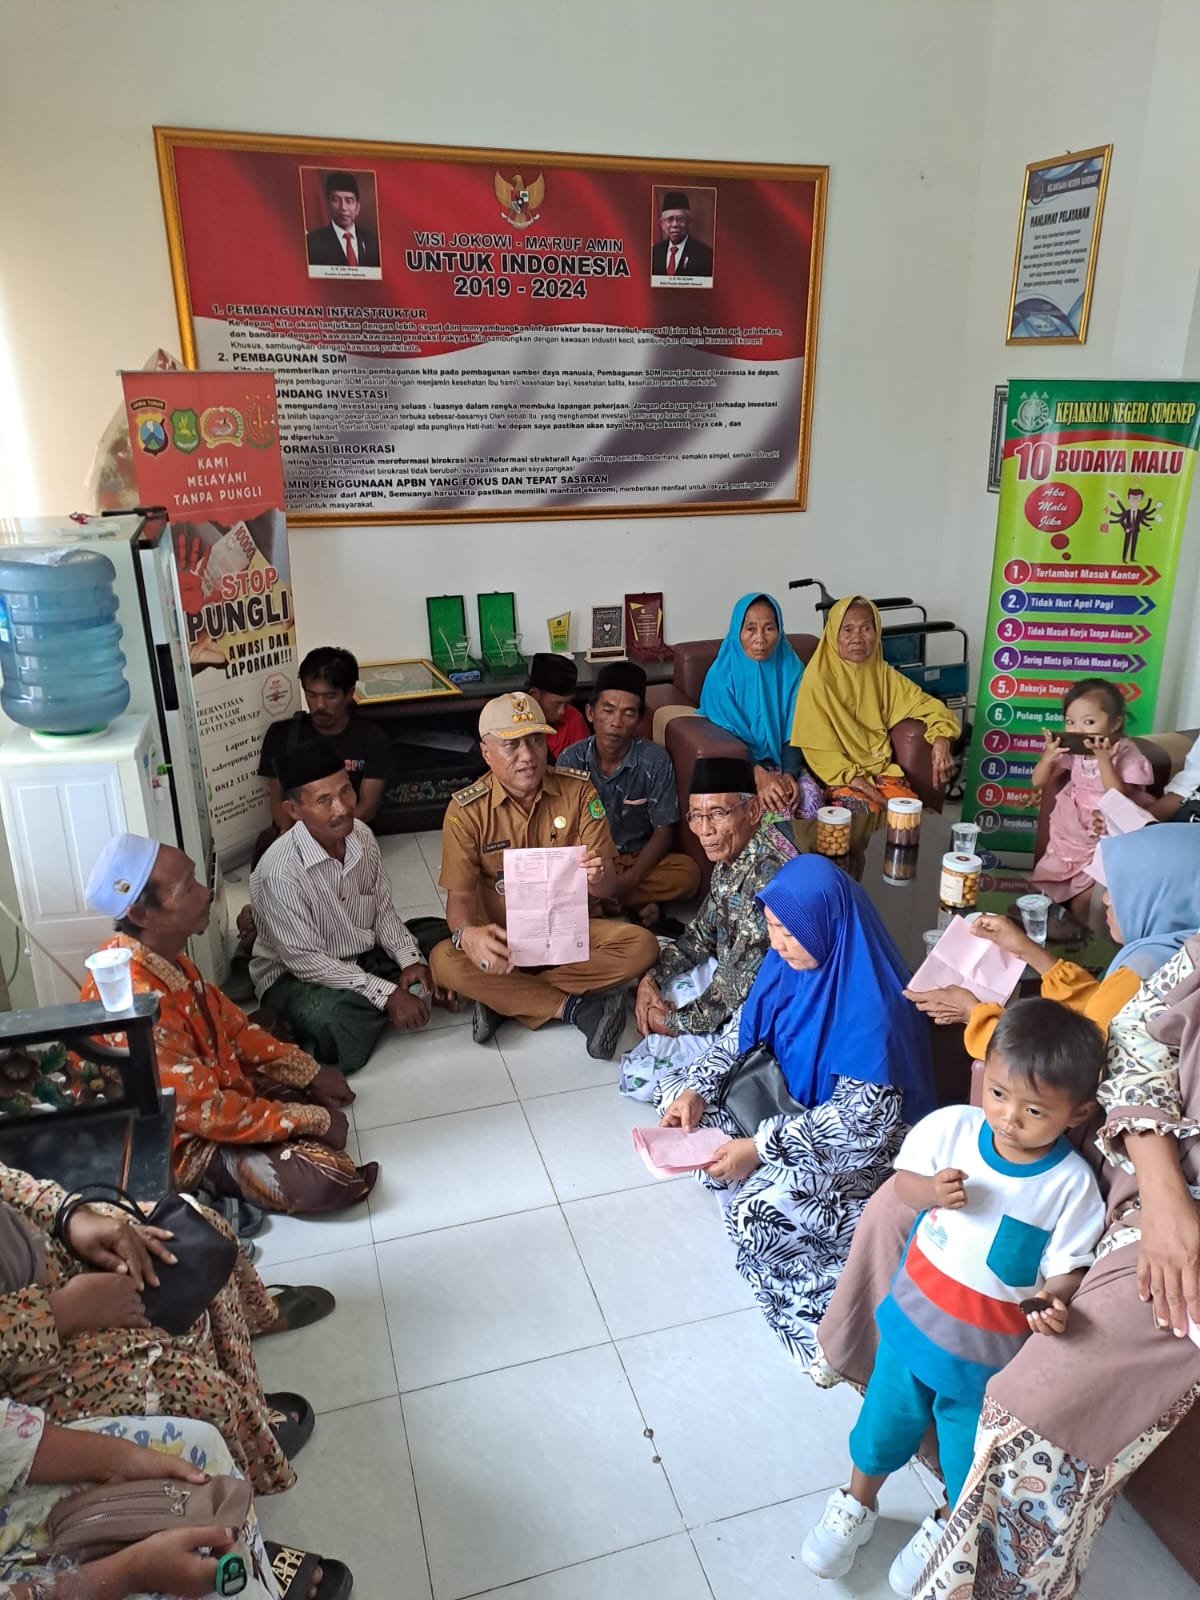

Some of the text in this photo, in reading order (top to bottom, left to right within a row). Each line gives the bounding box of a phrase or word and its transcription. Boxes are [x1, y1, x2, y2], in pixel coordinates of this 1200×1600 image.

[414, 231, 625, 253] VISI JOKOWI MA'RUF AMIN
[405, 250, 631, 278] UNTUK INDONESIA
[453, 276, 588, 300] 2019 2024
[213, 304, 428, 320] 1. PEMBANGUNAN INFRASTRUKTUR
[295, 321, 318, 330] akan
[229, 331, 246, 339] dan
[249, 331, 285, 340] bandara
[287, 332, 319, 342] dengan
[322, 332, 361, 342] kawasan
[363, 333, 401, 342] kawasan
[217, 352, 348, 363] 2. PEMBAGUNAN SDM
[278, 368, 329, 376] memberikan
[422, 369, 439, 377] kita
[440, 369, 460, 378] pada
[512, 369, 540, 377] sumber
[542, 369, 561, 378] daya
[645, 369, 661, 378] SDM
[326, 390, 389, 400] INVESTASI
[284, 402, 338, 411] mengundang
[340, 402, 378, 411] investasi
[379, 402, 399, 411] yang
[465, 402, 490, 410] dalam
[1055, 400, 1196, 426] KEJAKSAAN NEGERI SUMENEP
[533, 422, 552, 431] saya
[553, 421, 585, 431] pastikan
[586, 422, 605, 430] akan
[280, 444, 396, 455] ORMASI BIROKRASI
[197, 456, 229, 470] KAMI
[351, 457, 376, 466] untuk
[1013, 441, 1185, 482] 10 BUDAYA MALU
[187, 471, 248, 488] MELAYANI
[284, 474, 609, 489] MIN PENGGUNAAN APBN YANG FOKUS DAN TEPAT SASARAN
[173, 486, 263, 507] TANPA PUNGLI
[388, 489, 433, 499] Semuanya
[433, 489, 458, 498] harus
[477, 488, 513, 498] pastikan
[1037, 500, 1069, 513] Malu
[1037, 515, 1063, 529] Jika
[1011, 565, 1141, 581] 1. Terlambat Masuk Kantor
[221, 567, 278, 600] STOP
[1006, 593, 1115, 611] 2. Tidak Ikut Apel Pagi
[185, 589, 291, 645] PUNGLI
[1003, 623, 1135, 640] 3. Tidak Masuk Kerja Tanpa Alasan
[228, 631, 290, 662] AWASI DAN
[225, 647, 293, 680] LAPORKAN!!!
[1000, 651, 1014, 666] 4.
[1023, 654, 1043, 667] Sering
[1043, 656, 1062, 666] Minta
[1073, 656, 1090, 667] Tidak
[1091, 657, 1111, 668] Masuk
[1111, 658, 1130, 670] Kerja
[996, 680, 1010, 695] 5.
[1019, 682, 1047, 696] Bekerja
[993, 707, 1065, 723] 6. Pulang Sebe
[991, 734, 1005, 750] 7.
[1011, 737, 1029, 748] Tidak
[987, 761, 1001, 776] 8.
[984, 787, 999, 802] 9.
[978, 814, 998, 829] 10.
